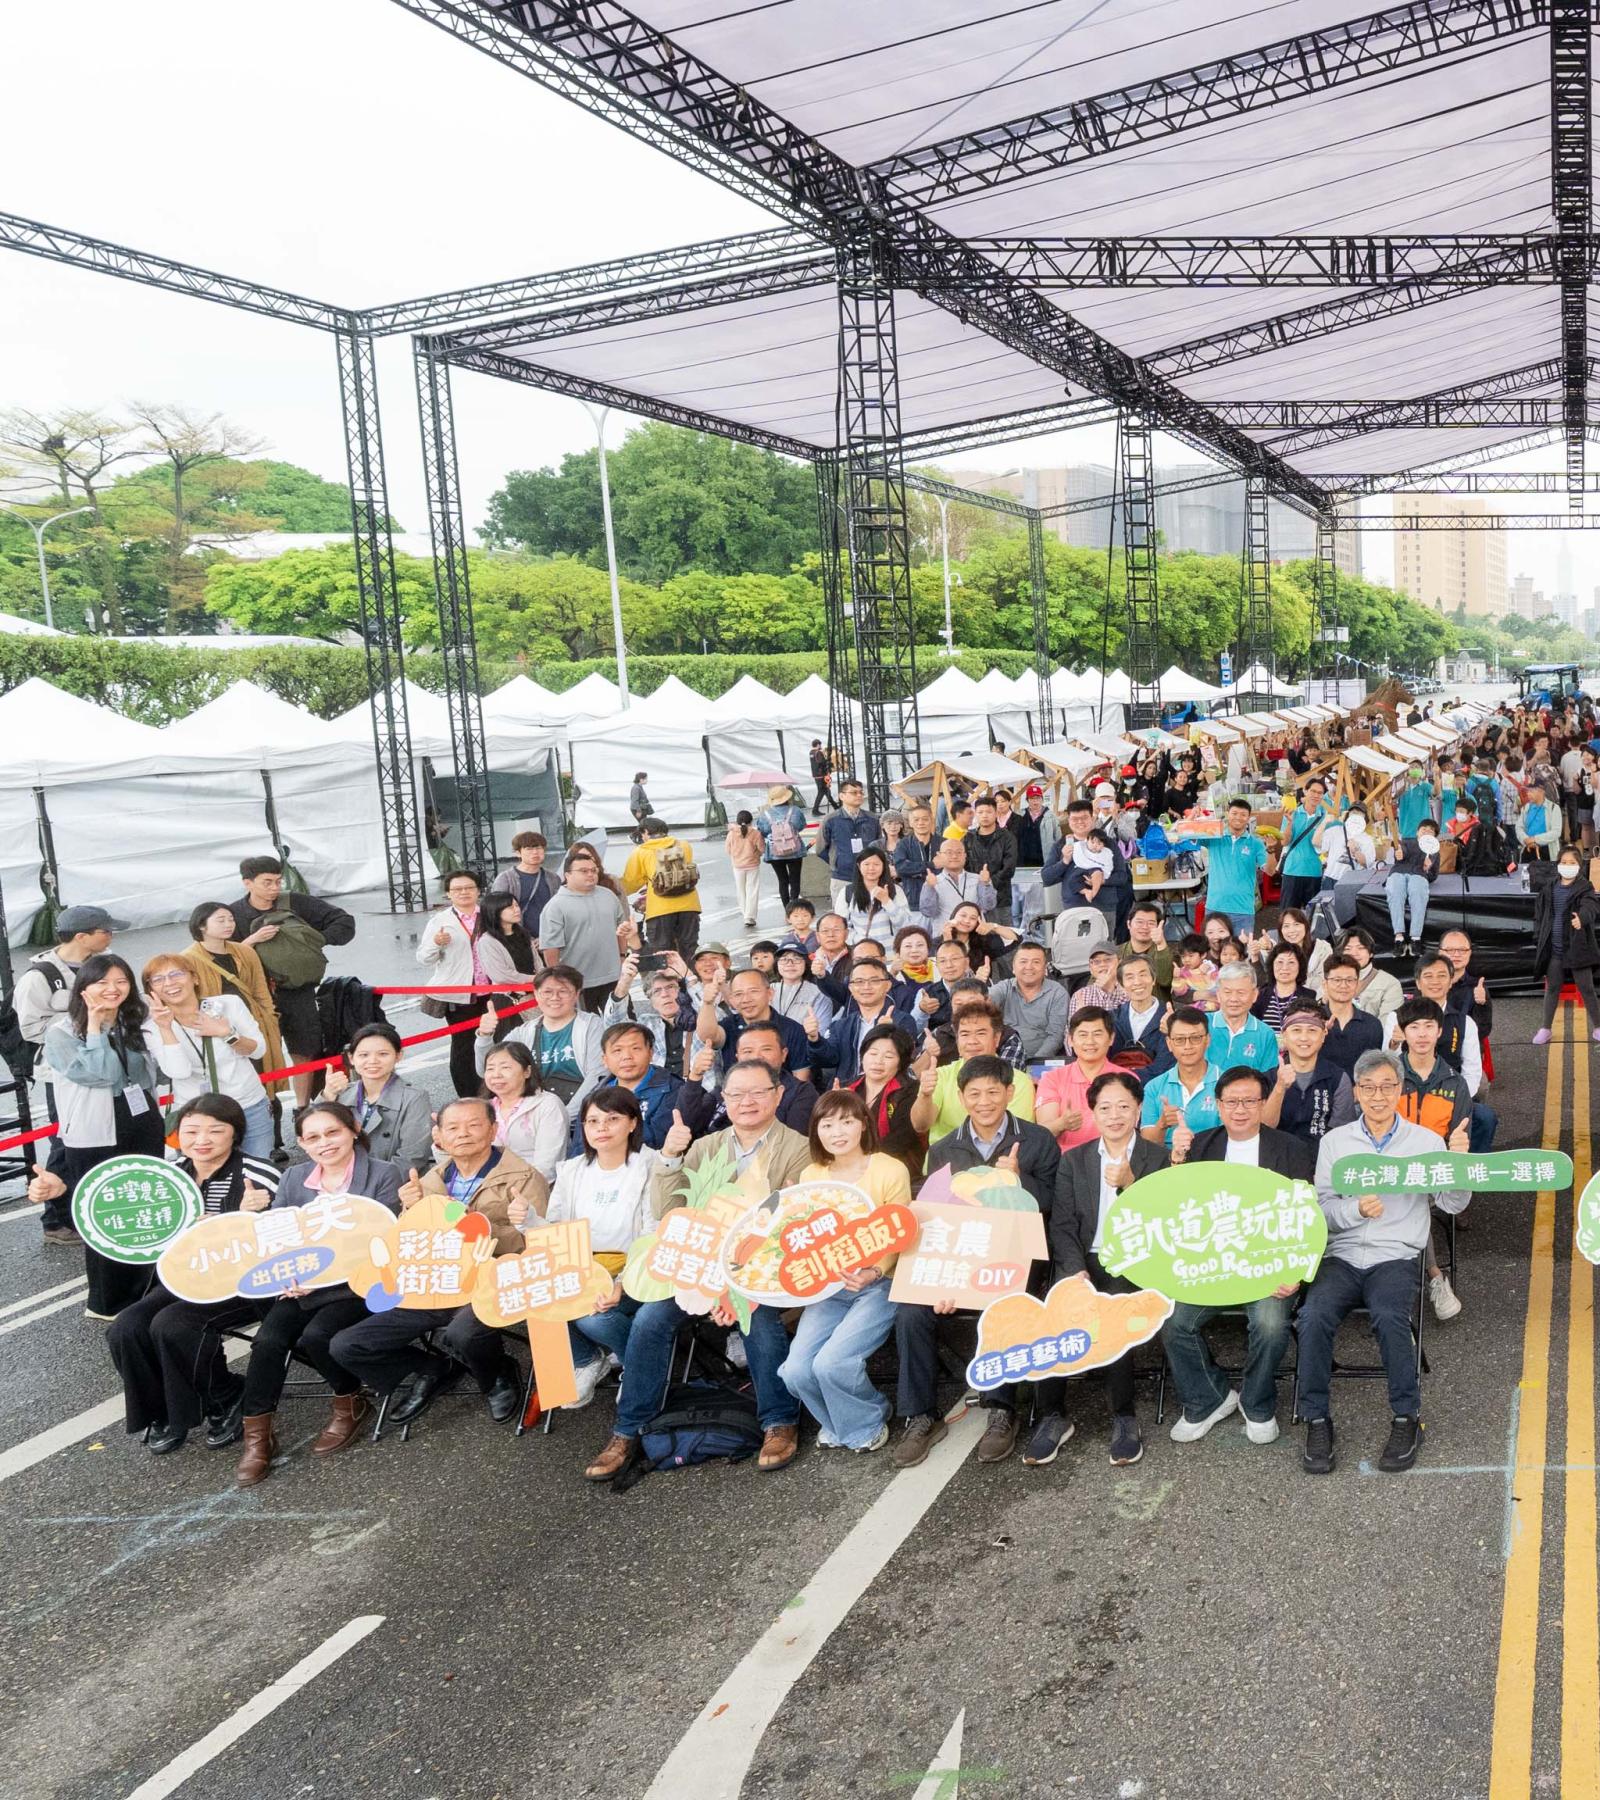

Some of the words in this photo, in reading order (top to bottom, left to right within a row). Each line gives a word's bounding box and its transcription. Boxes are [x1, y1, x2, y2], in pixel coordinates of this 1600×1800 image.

[101, 1180, 171, 1202] 台灣農產
[1342, 1161, 1456, 1188] #台灣農產
[1466, 1160, 1556, 1183] 唯一選擇
[103, 1207, 172, 1229] 唯一選擇
[190, 1195, 356, 1273] 小小農夫
[663, 1214, 715, 1253] 農玩
[785, 1212, 838, 1253] 來呷
[1111, 1183, 1317, 1273] 凱道農玩節
[132, 1234, 159, 1243] 2026
[398, 1230, 466, 1261] 彩繪
[784, 1211, 906, 1292] 割稻飯!
[918, 1216, 993, 1258] 食農
[252, 1252, 321, 1287] 出任務
[396, 1264, 462, 1295] 街道
[496, 1251, 551, 1288] 農玩
[910, 1257, 972, 1289] 體驗
[977, 1268, 1017, 1287] DIY
[498, 1271, 582, 1316] 迷宮趣
[975, 1332, 1087, 1383] 稻草藝術
